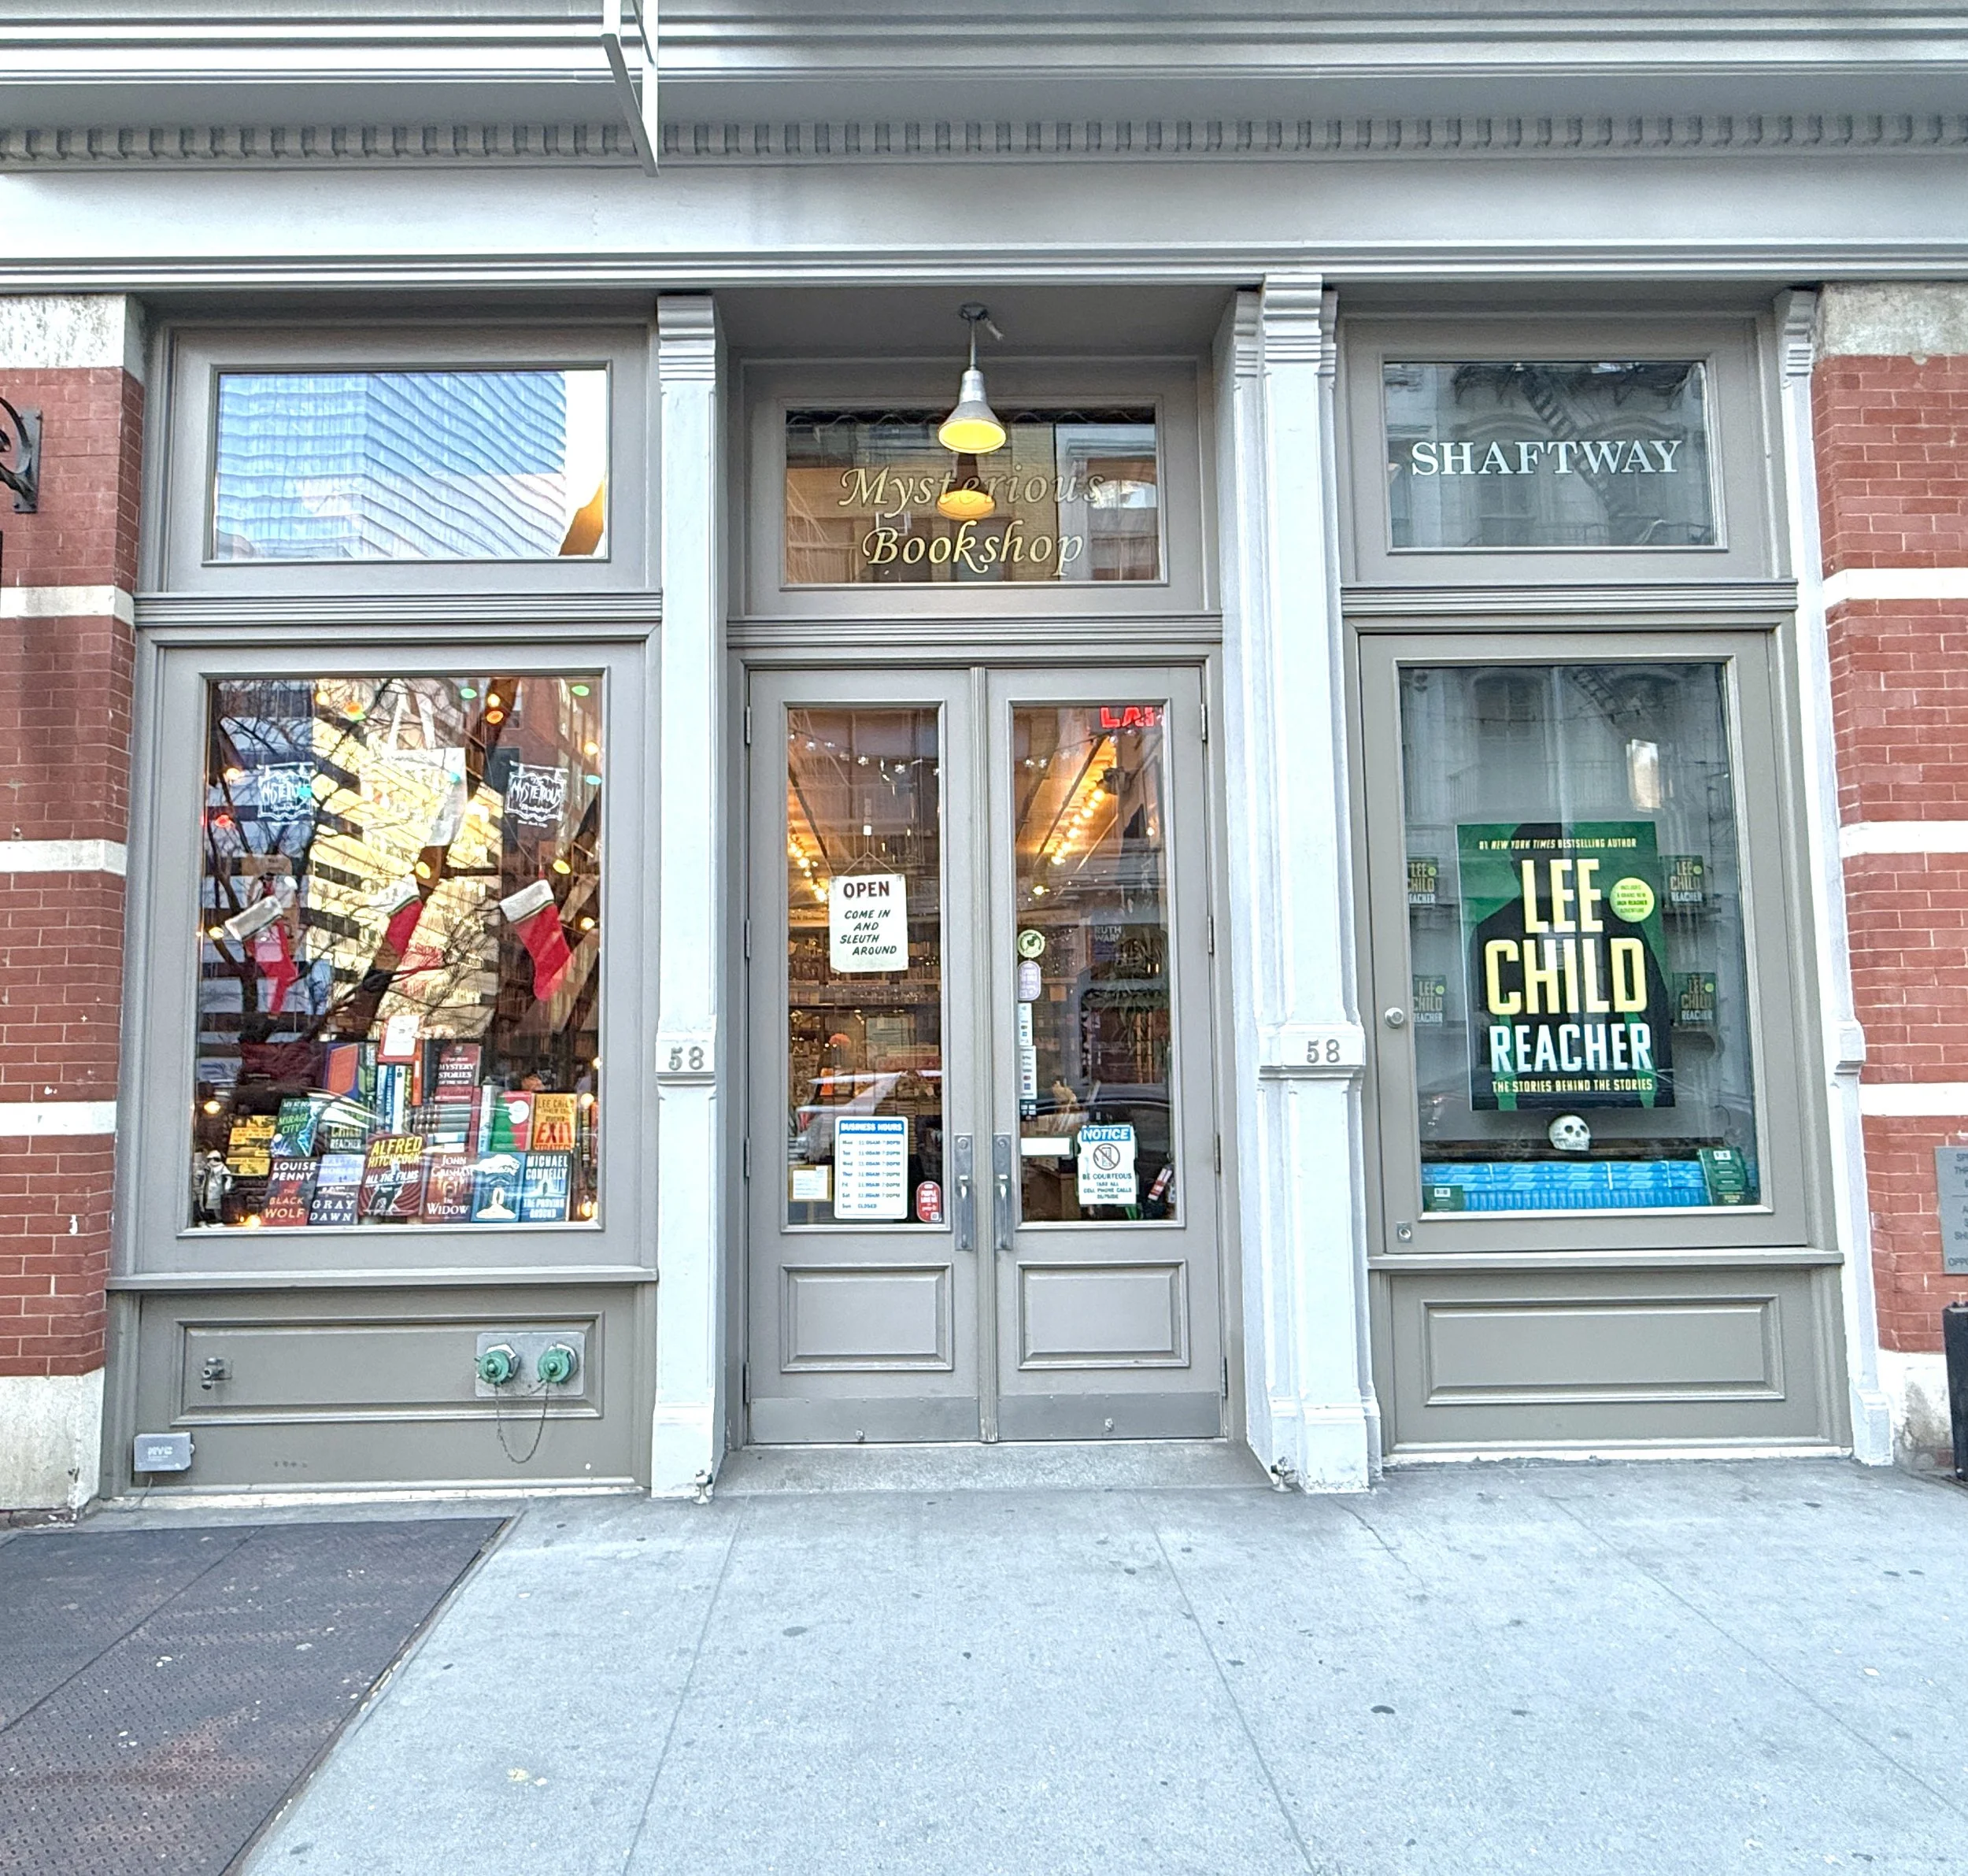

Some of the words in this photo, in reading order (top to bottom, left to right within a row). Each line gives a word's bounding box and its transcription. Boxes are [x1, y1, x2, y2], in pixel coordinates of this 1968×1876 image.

[1411, 439, 1683, 475] SHAFTWAY
[837, 464, 1106, 519] Mysterious
[862, 520, 1083, 577] Bookshop
[1491, 839, 1509, 850] NEW
[1511, 838, 1530, 850] YORK
[1533, 838, 1556, 849] TIMES
[1557, 838, 1605, 849] BESTSELLING
[1607, 838, 1637, 848] AUTHOR
[843, 881, 890, 898] OPEN
[1408, 894, 1436, 904] EACHER
[1521, 858, 1604, 934] LEE
[844, 909, 875, 919] COME
[878, 909, 891, 918] IN
[853, 922, 879, 931] AND
[1094, 925, 1123, 934] RUTH
[839, 934, 880, 944] SLEUTH
[852, 945, 897, 956] AROUND
[1485, 938, 1648, 1015] CHILD
[1307, 1039, 1340, 1064] 58
[1489, 1023, 1652, 1073] REACHER
[668, 1046, 705, 1071] 58
[1492, 1081, 1509, 1093] THE
[1512, 1080, 1552, 1093] STORIES
[1556, 1079, 1591, 1092] BEHIND
[1594, 1079, 1611, 1091] THE
[1614, 1079, 1653, 1091] STORIES
[282, 1124, 300, 1134] CITY
[536, 1121, 573, 1143] EXIT
[1083, 1128, 1129, 1140] NOTICE
[330, 1138, 362, 1149] REACHER
[371, 1136, 424, 1156] ALFRED
[273, 1162, 316, 1171] LOUISE
[526, 1155, 568, 1167] MICHAEL
[272, 1172, 313, 1181] PENNY
[365, 1174, 379, 1184] ALL
[395, 1170, 419, 1181] FILMS
[525, 1168, 568, 1180] CONNELLY
[269, 1196, 304, 1205] BLACK
[312, 1200, 354, 1209] GRAY
[264, 1208, 305, 1219] WOLF
[309, 1212, 352, 1221] DAWN
